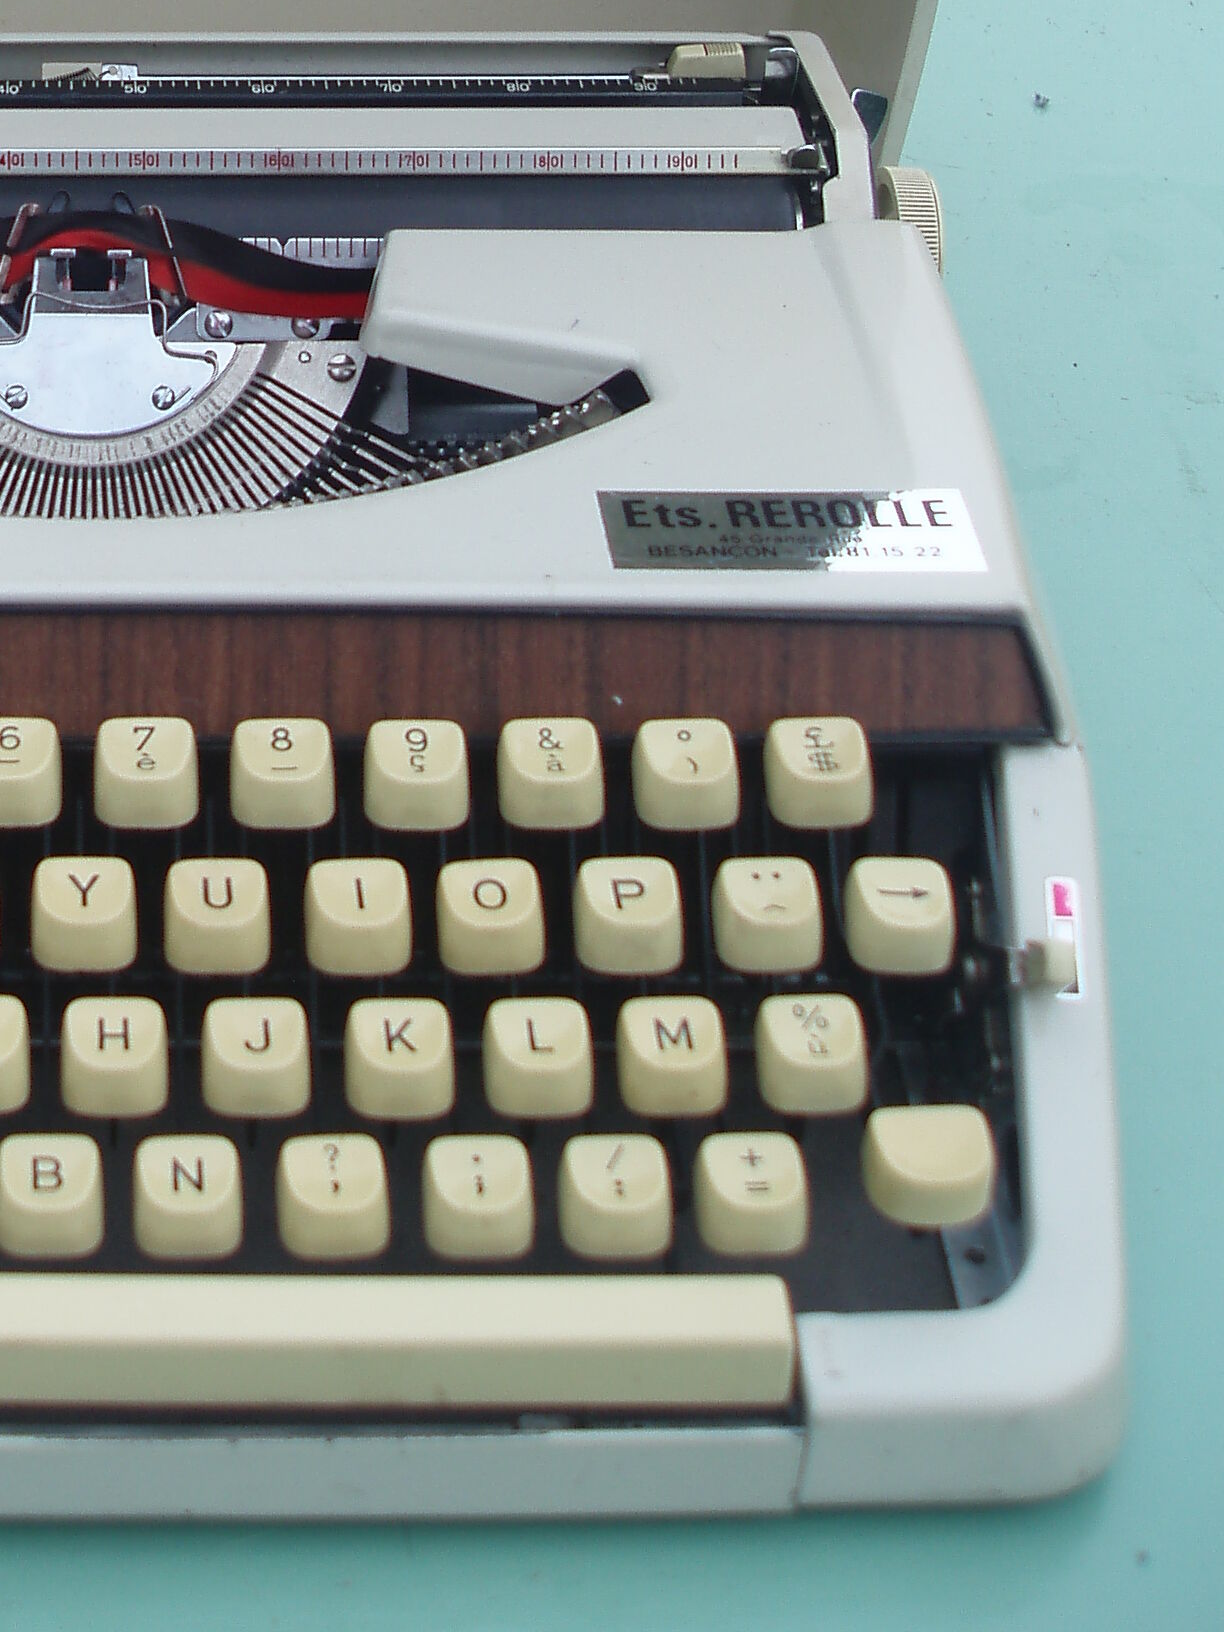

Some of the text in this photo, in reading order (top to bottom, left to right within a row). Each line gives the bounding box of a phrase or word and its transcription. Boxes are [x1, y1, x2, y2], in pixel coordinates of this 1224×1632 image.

[124, 84, 147, 95] 50
[0, 153, 20, 167] 40
[134, 153, 155, 167] 50
[621, 499, 954, 528] Ets. REROLLE
[133, 726, 156, 751] 7
[271, 727, 293, 751] 8
[405, 728, 428, 752] 9
[539, 727, 563, 750] &
[69, 874, 100, 906] Y
[203, 876, 234, 908] U
[473, 878, 507, 909] O
[612, 879, 645, 909] P
[96, 1017, 130, 1051] H
[244, 1018, 273, 1052] J
[384, 1018, 417, 1053] K
[525, 1019, 554, 1052] L
[654, 1017, 693, 1052] M
[322, 1143, 341, 1171] ?
[32, 1156, 64, 1191] B
[171, 1156, 203, 1192] N
